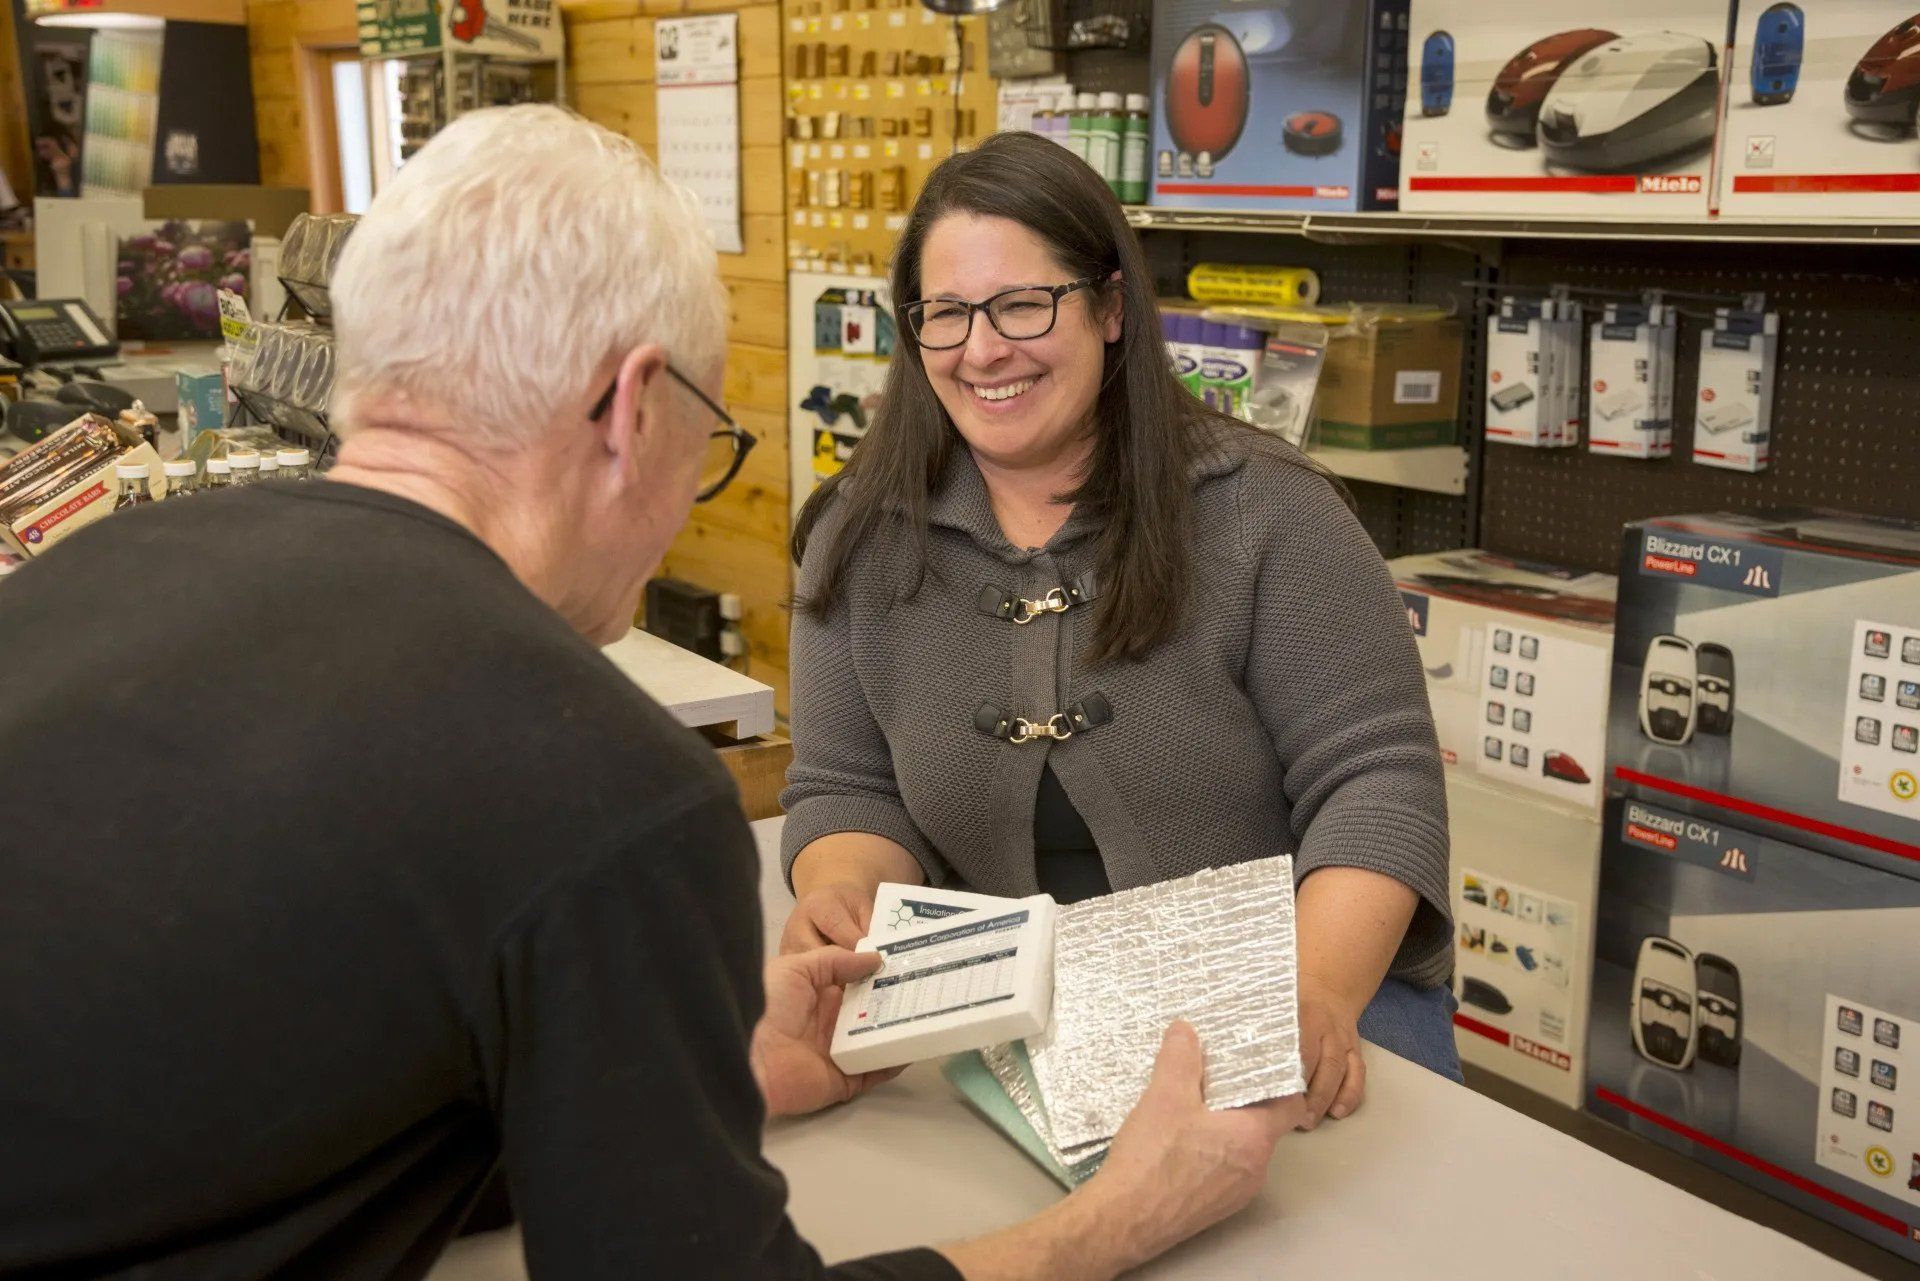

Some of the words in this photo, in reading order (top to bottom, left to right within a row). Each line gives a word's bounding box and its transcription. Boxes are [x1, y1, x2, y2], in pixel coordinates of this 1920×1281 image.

[1641, 176, 1701, 193] Miele
[39, 498, 82, 529] CHOCOLATE
[82, 487, 102, 503] BARS
[28, 529, 40, 541] 48
[1646, 535, 1705, 561] Blizzard
[1645, 555, 1696, 575] PowerLine
[1629, 805, 1685, 836] Blizzard
[1628, 824, 1677, 848] PowerLine
[893, 938, 928, 952] Insulation
[929, 926, 976, 943] Corporation
[977, 922, 986, 932] of
[987, 916, 1021, 928] America
[1516, 1038, 1569, 1069] Miele
